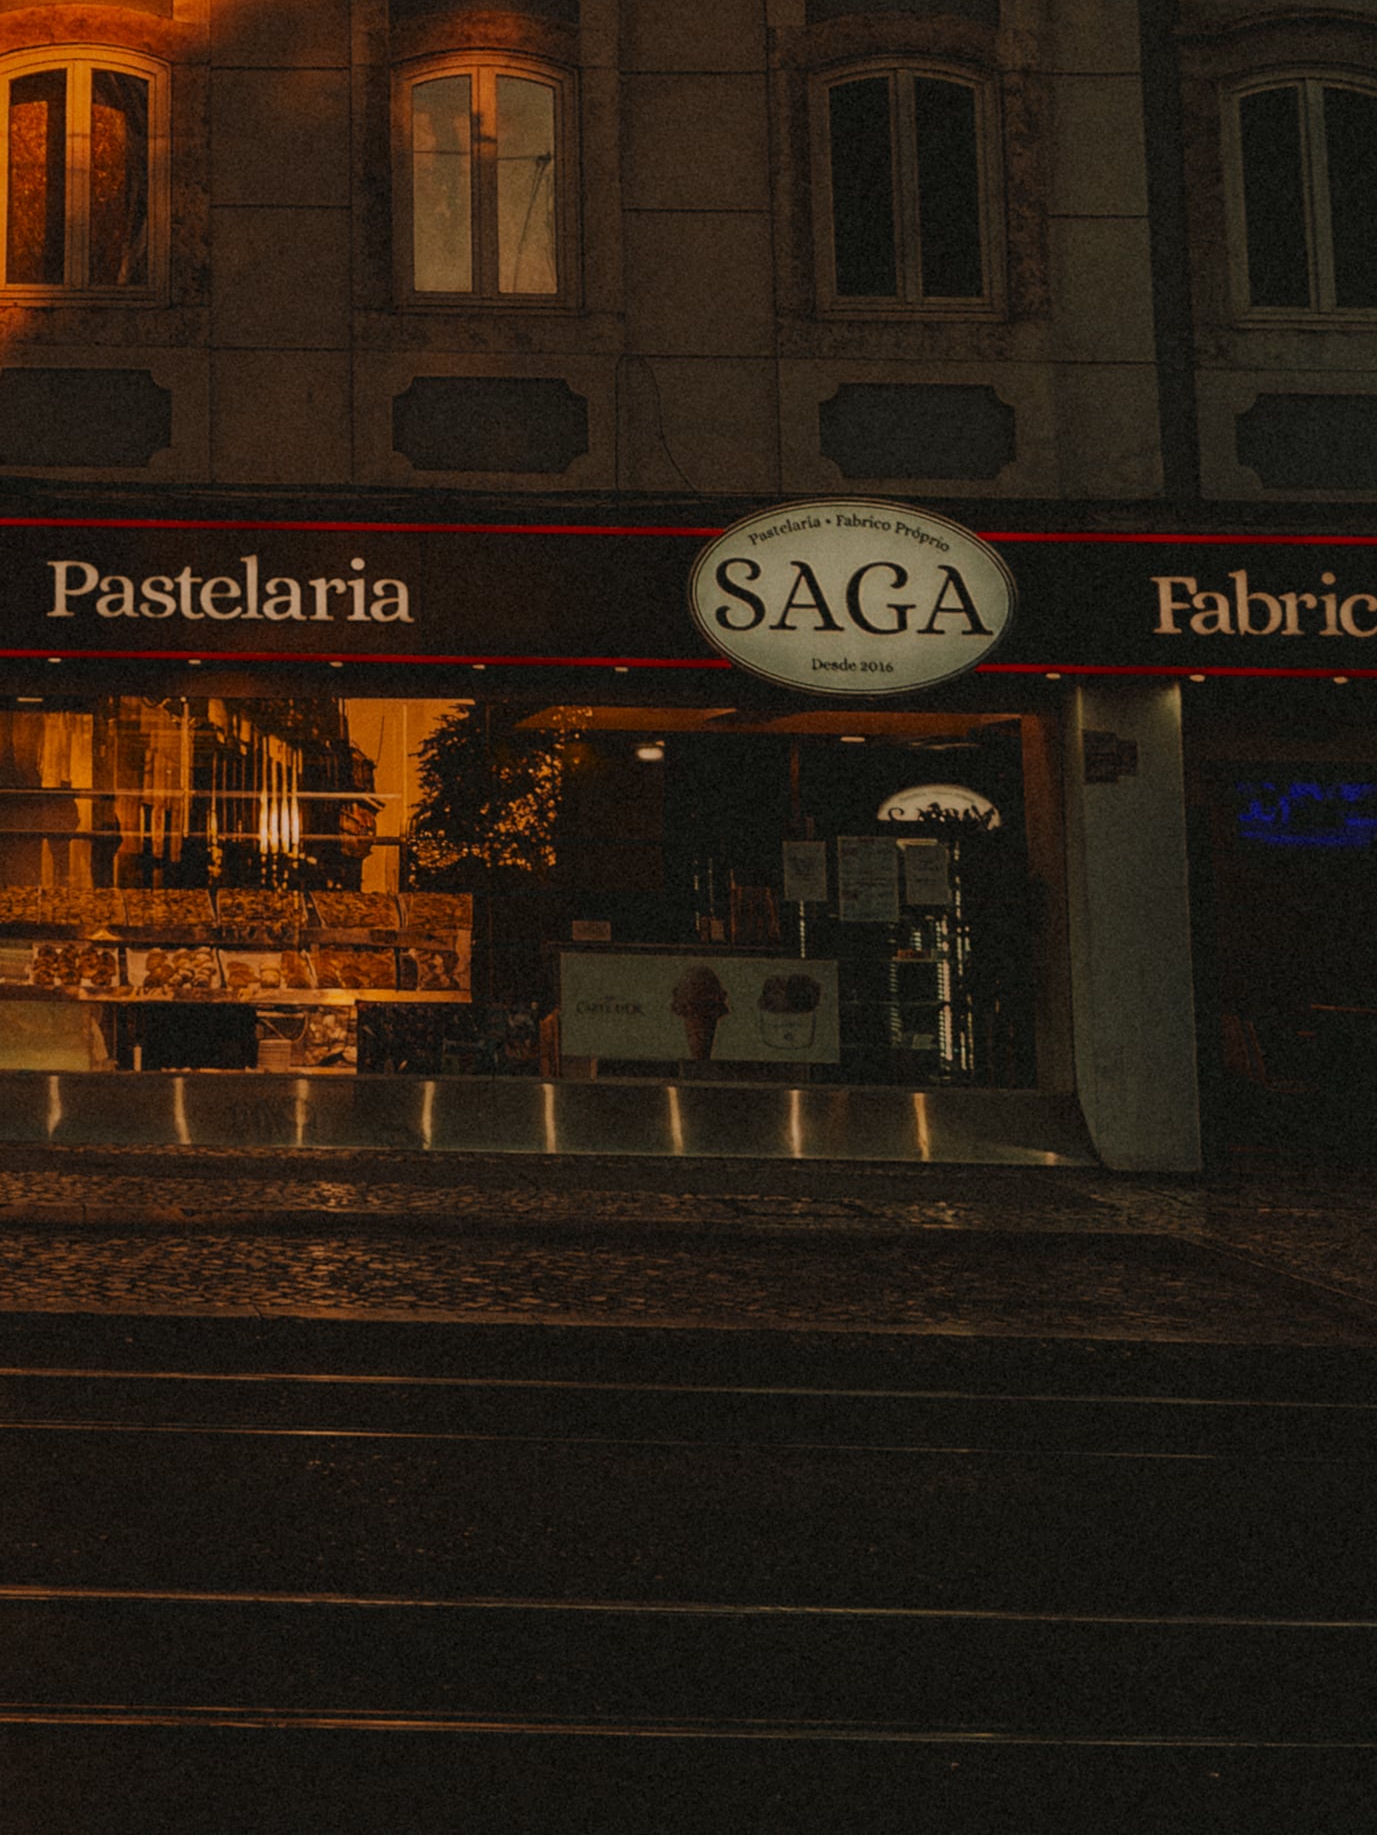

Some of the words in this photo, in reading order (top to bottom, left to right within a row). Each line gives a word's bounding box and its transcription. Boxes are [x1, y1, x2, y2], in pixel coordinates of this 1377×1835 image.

[747, 515, 822, 546] Pastelaria
[835, 514, 892, 532] Fabrico
[894, 521, 951, 552] Próprio
[45, 554, 416, 624] Pastelaria
[715, 557, 994, 636] SAGA
[1149, 568, 1377, 639] Fabric
[811, 657, 857, 671] Desde
[860, 661, 894, 673] 2016
